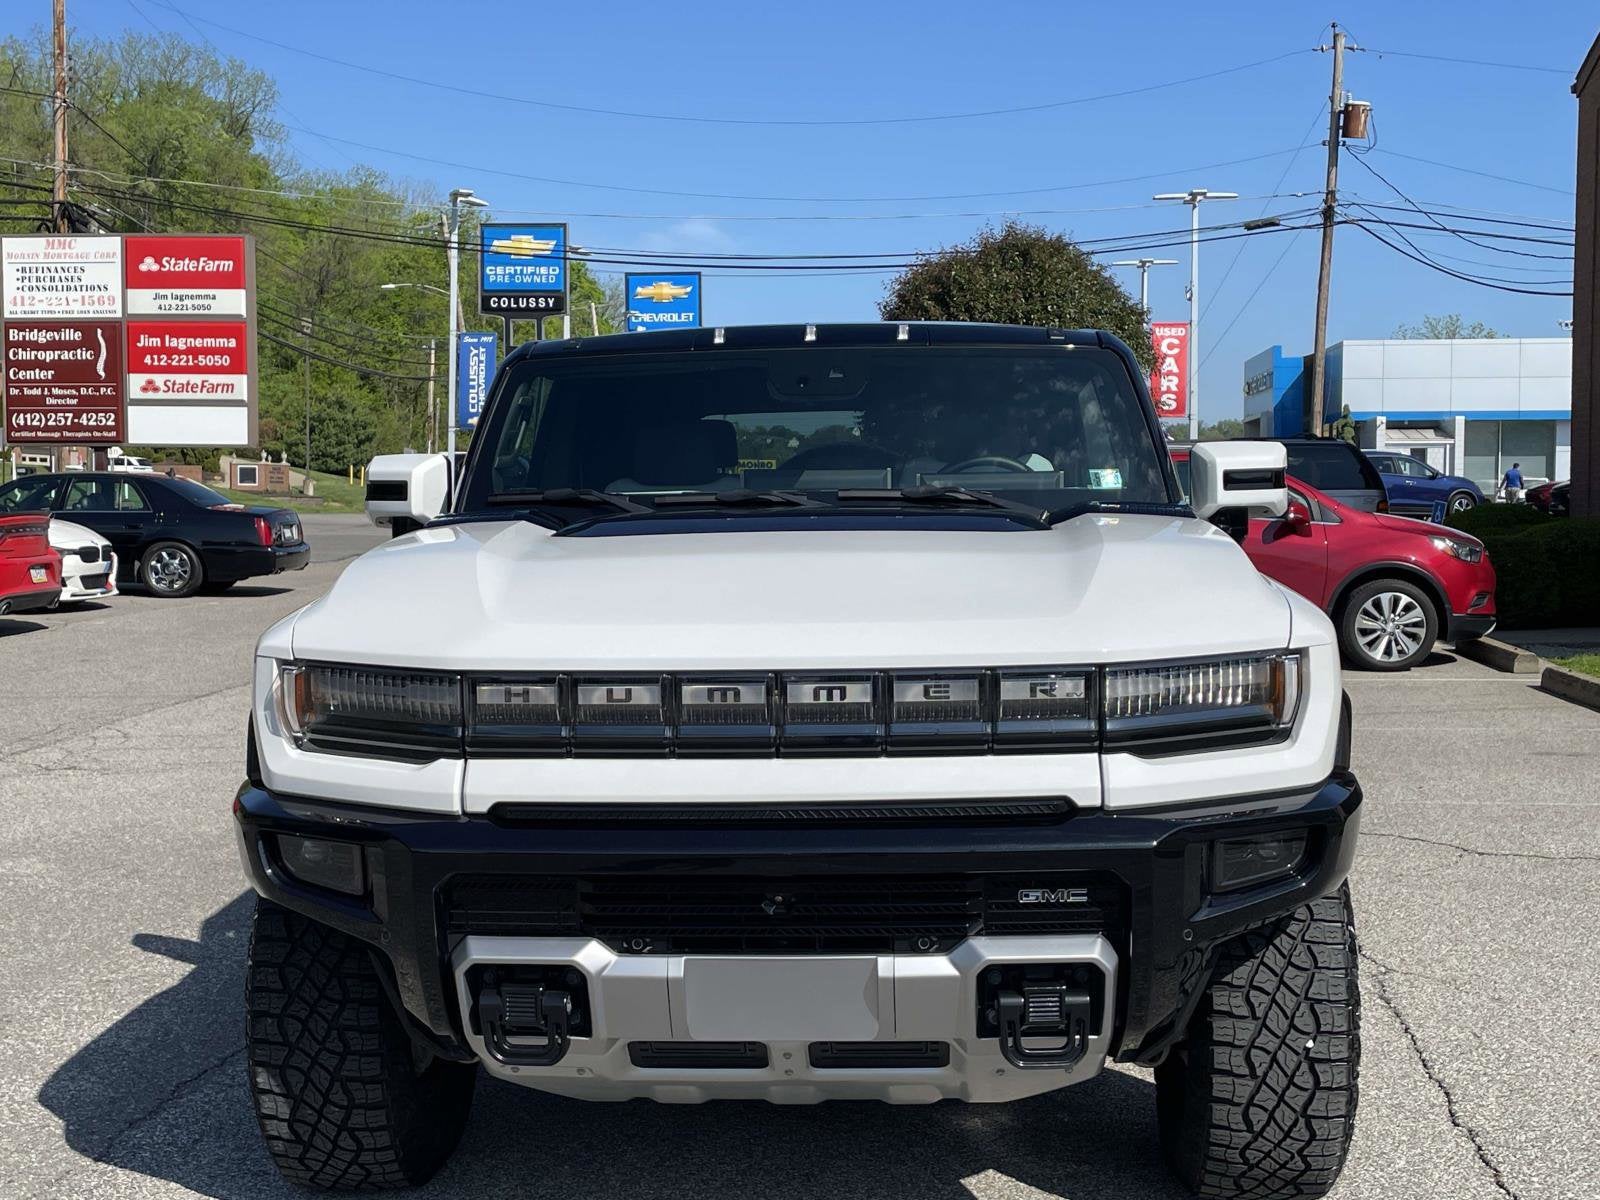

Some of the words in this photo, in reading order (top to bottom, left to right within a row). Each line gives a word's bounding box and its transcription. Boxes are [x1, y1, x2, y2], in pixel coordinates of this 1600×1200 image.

[44, 238, 77, 250] MMC
[43, 251, 91, 260] MORTGAGE
[21, 266, 86, 274] REFINANCES
[486, 266, 560, 275] CERTIFIED
[21, 275, 82, 283] PURCHASES
[489, 275, 556, 283] PRE-OWNED
[21, 284, 109, 292] CONSOLIDATIONS
[9, 295, 116, 307] 412-221-1569
[152, 292, 168, 301] Jim
[157, 303, 212, 312] 412-221-5050
[490, 297, 555, 308] COLUSSY
[9, 329, 82, 344] Bridgeville
[1155, 327, 1186, 336] USED
[136, 335, 161, 348] Jim
[8, 348, 95, 363] Chiropractic
[143, 355, 230, 367] 412-221-5050
[9, 368, 55, 380] Center
[469, 346, 479, 413] COLUSSY
[9, 387, 22, 396] Dr.
[23, 387, 42, 396] Todd
[46, 397, 79, 405] Director
[11, 412, 46, 428] (412)
[47, 412, 116, 426] 257-4252
[1017, 888, 1088, 903] GMC
